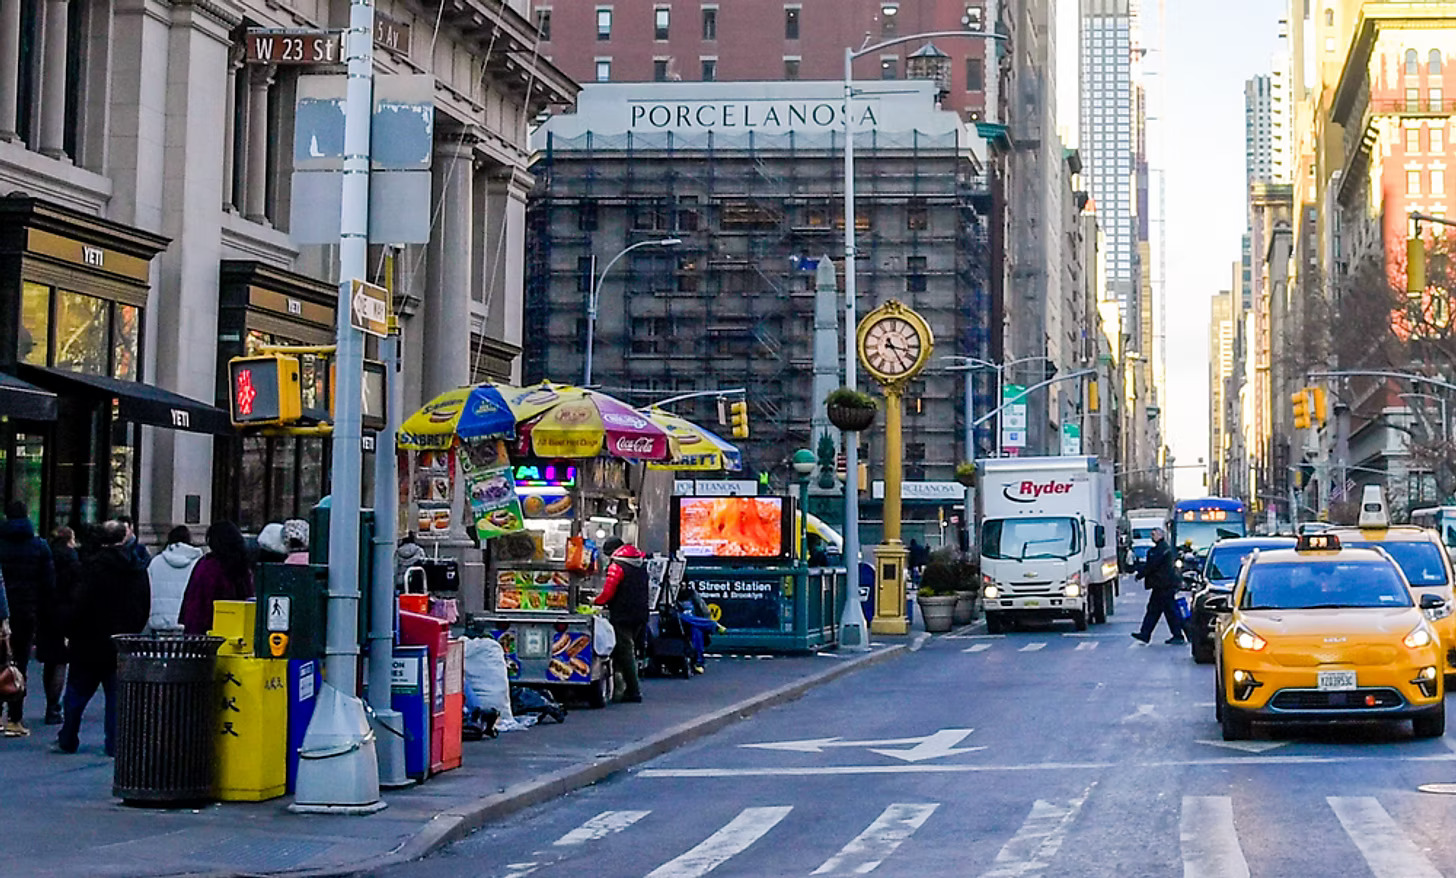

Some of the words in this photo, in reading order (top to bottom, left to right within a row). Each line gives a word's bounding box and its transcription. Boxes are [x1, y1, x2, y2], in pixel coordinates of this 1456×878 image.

[377, 21, 384, 41] 5
[386, 26, 400, 48] Av
[256, 38, 273, 60] W
[282, 39, 303, 60] 23
[313, 39, 333, 61] St
[83, 245, 105, 267] YETI
[170, 408, 190, 428] YETI
[616, 436, 655, 453] Coca-Cola
[1019, 480, 1074, 498] Ryder
[698, 581, 731, 591] Street
[733, 581, 772, 591] Station
